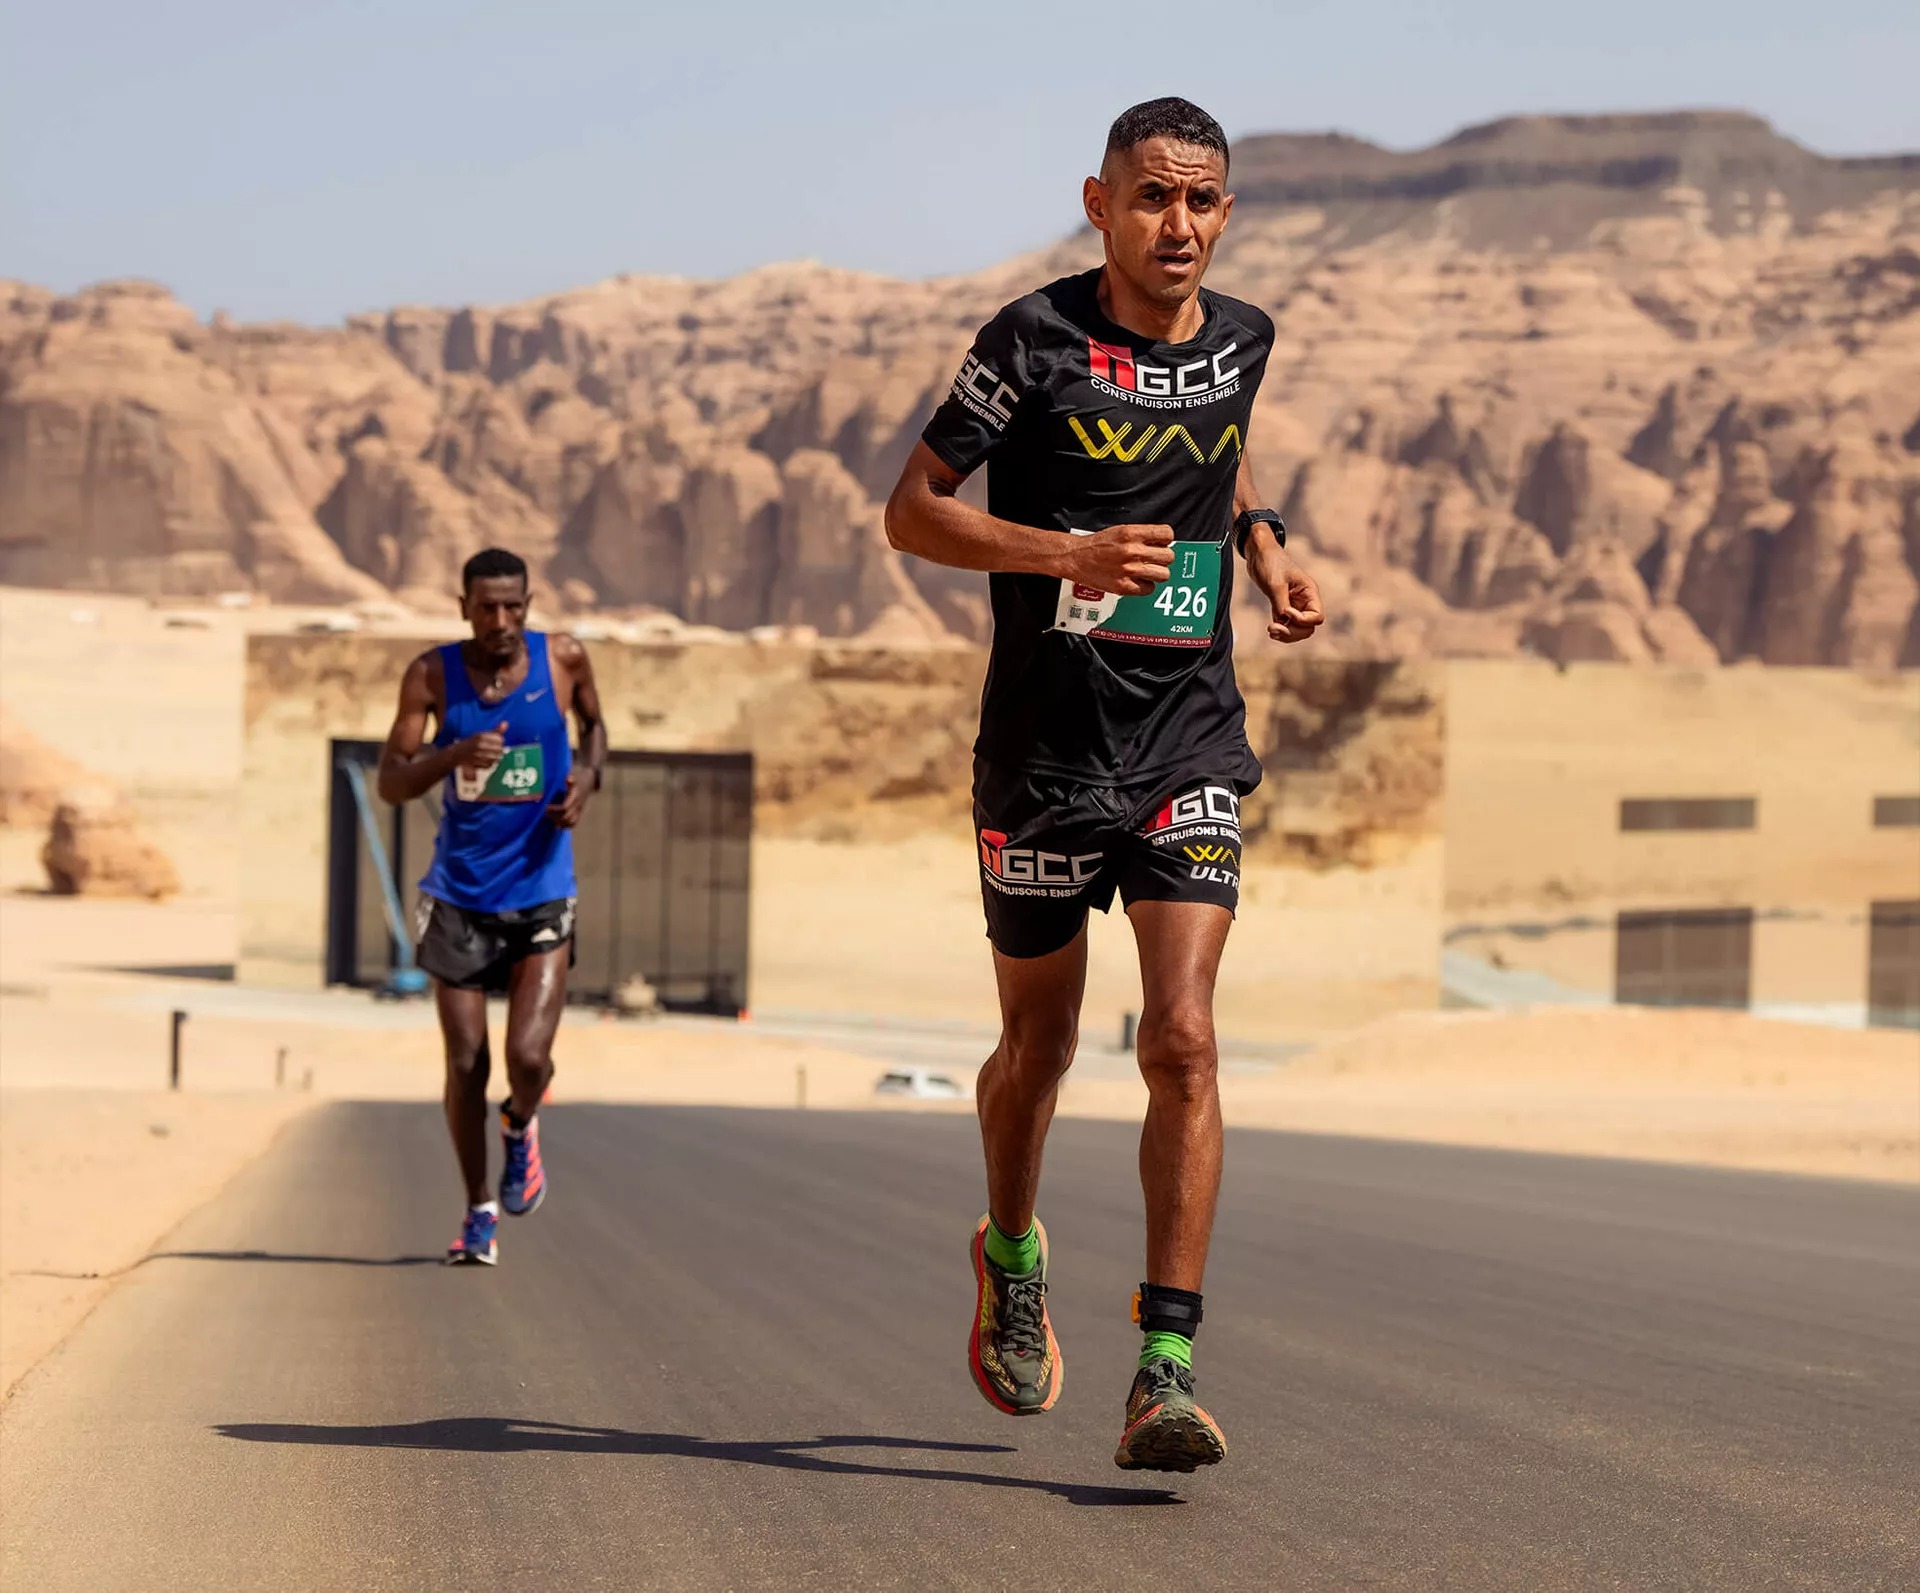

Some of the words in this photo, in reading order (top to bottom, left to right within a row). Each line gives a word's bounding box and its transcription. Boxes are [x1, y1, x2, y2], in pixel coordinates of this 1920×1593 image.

[1090, 378, 1182, 409] CONSTRUISON
[1185, 379, 1241, 408] ENSEMBLE
[963, 397, 1006, 432] ENSEMBLE
[1153, 586, 1208, 618] 426
[1170, 624, 1193, 634] 42KM
[501, 766, 538, 789] 429
